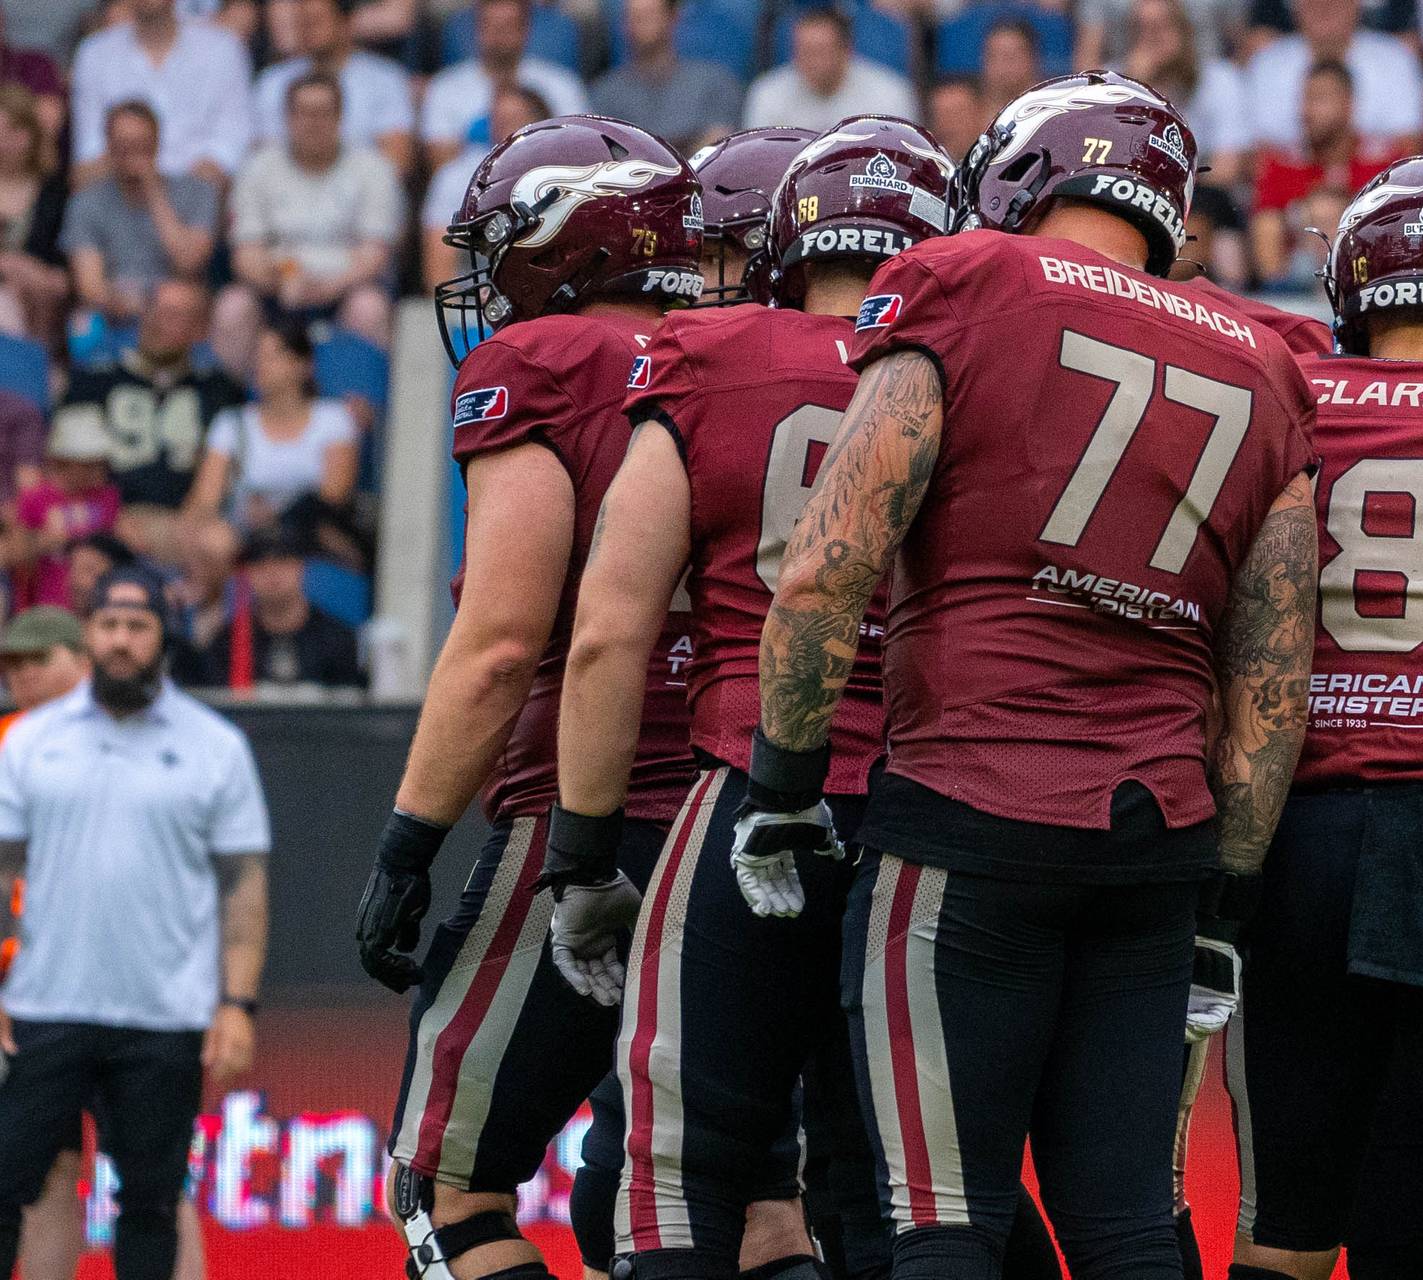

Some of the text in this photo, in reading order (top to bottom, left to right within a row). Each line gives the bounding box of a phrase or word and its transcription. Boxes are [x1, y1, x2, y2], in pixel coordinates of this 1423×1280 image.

[1082, 138, 1112, 164] 77
[851, 176, 908, 191] BURNHARD
[798, 196, 818, 222] 68
[1039, 256, 1256, 349] BREIDENBACH
[1039, 329, 1253, 575] 77
[1032, 565, 1200, 621] AMERICAN
[1314, 719, 1367, 729] SINCE 1933
